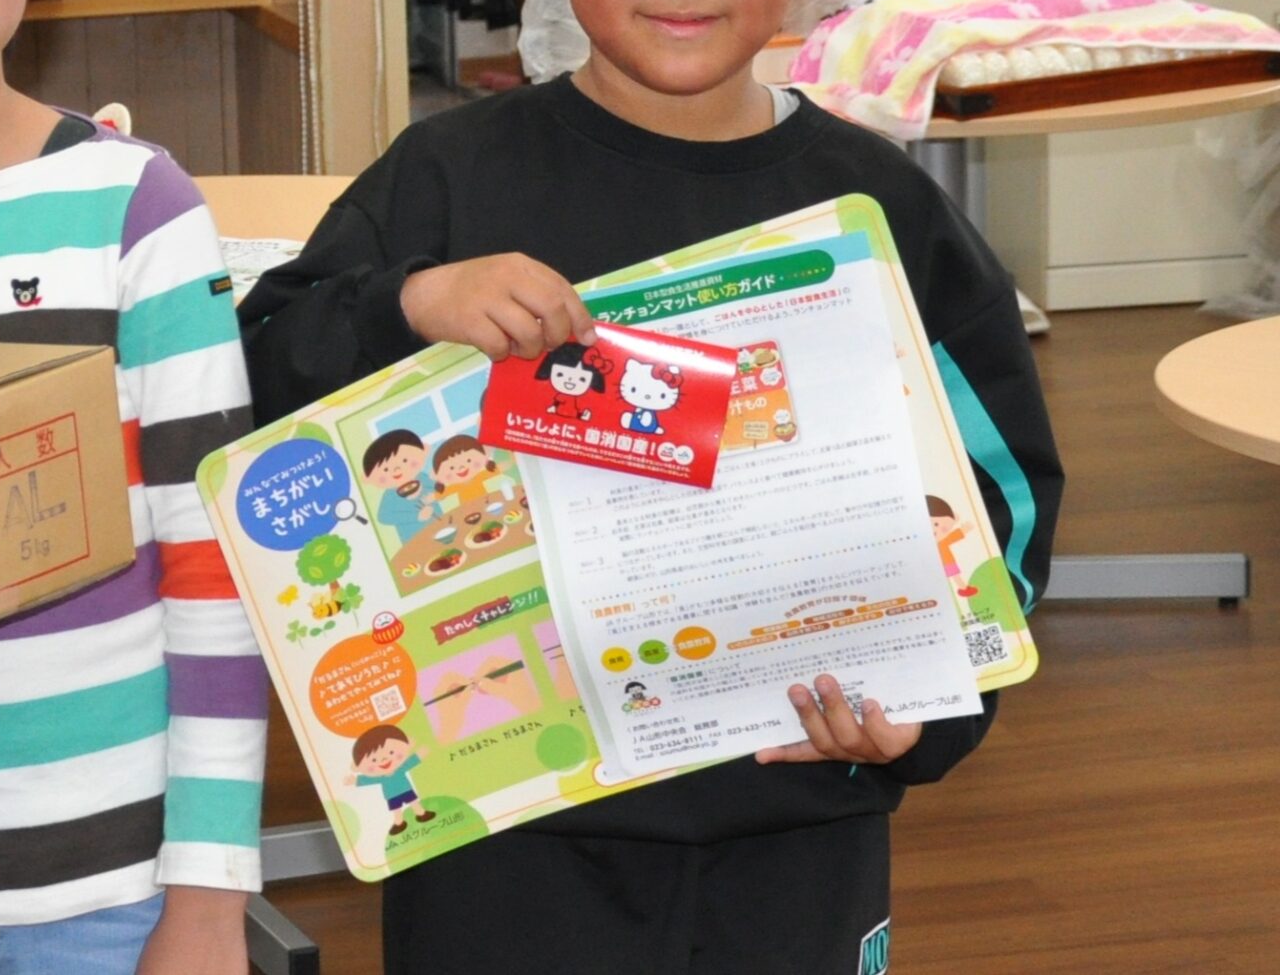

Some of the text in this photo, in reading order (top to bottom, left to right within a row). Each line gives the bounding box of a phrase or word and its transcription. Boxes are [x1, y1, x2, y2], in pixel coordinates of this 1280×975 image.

[243, 450, 327, 498] みんなでみつけよう!
[251, 467, 334, 519] まちがい
[270, 500, 332, 536] さがし
[443, 590, 540, 637] たのしくチャレンジ!!
[458, 720, 543, 759] だるまさん だるまさん
